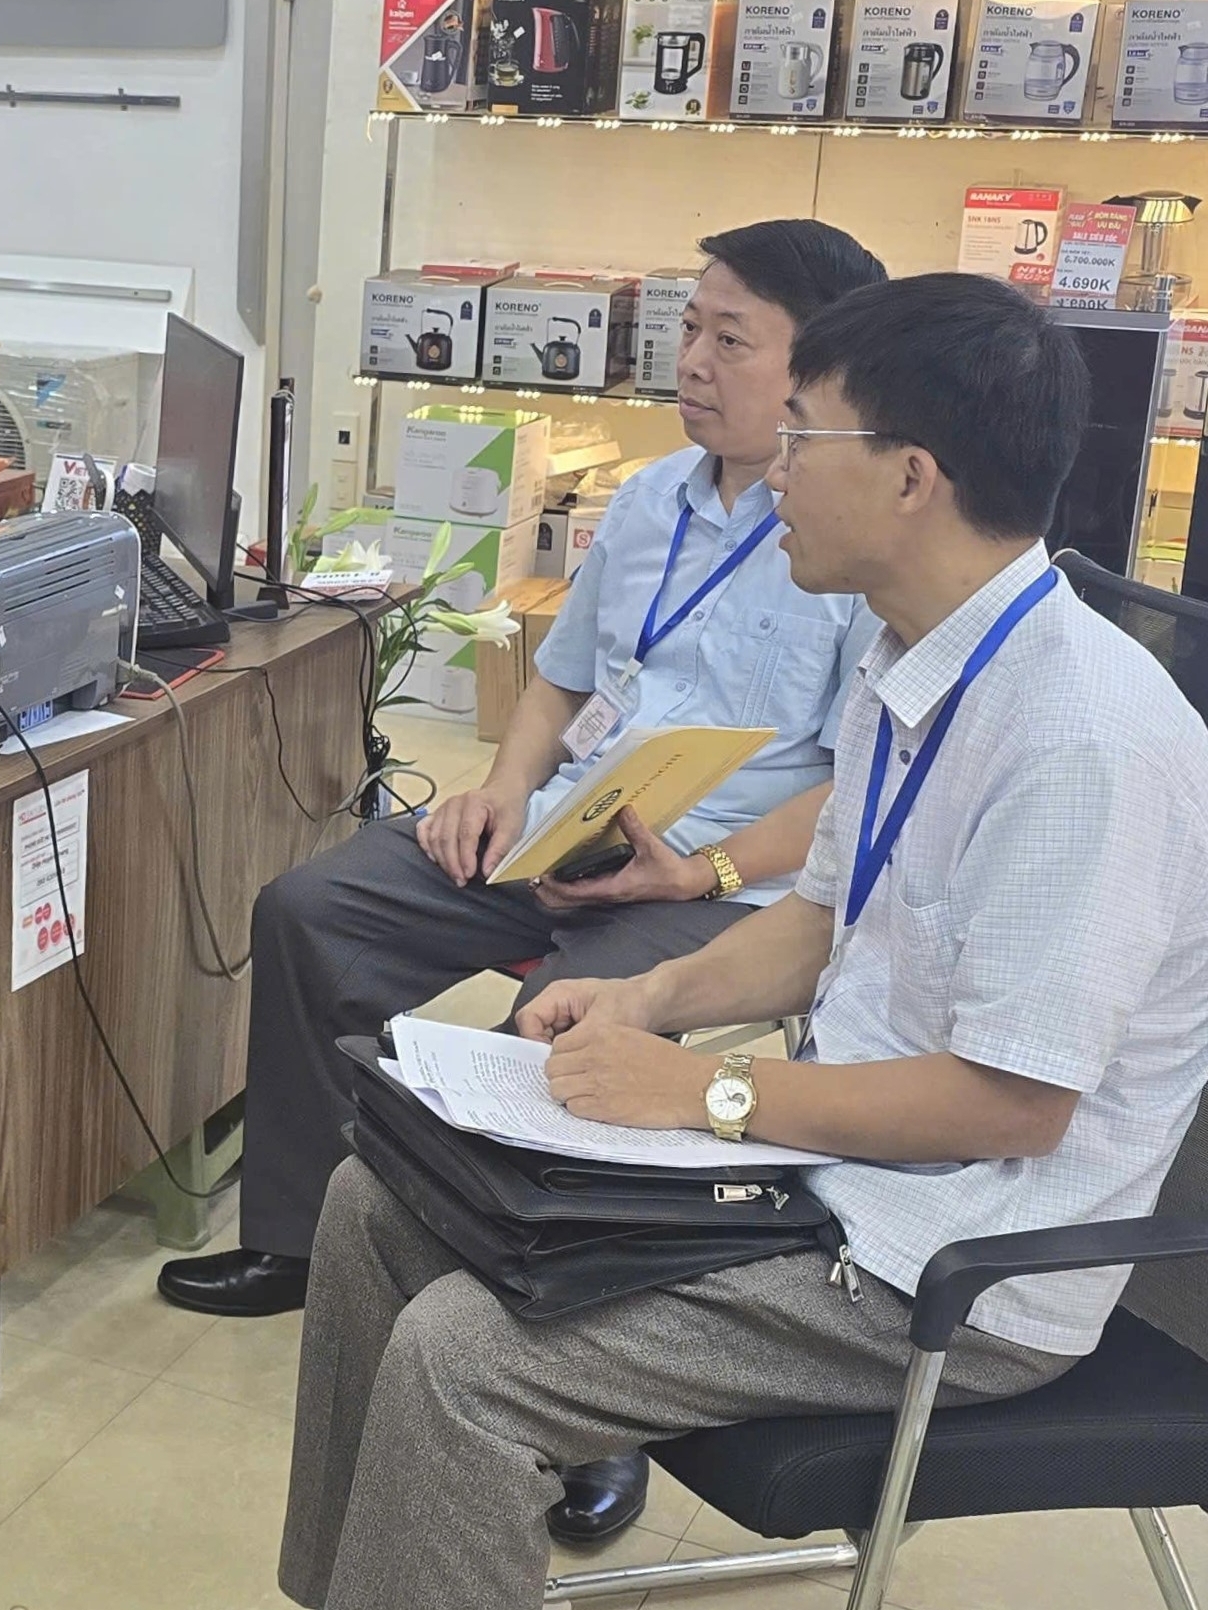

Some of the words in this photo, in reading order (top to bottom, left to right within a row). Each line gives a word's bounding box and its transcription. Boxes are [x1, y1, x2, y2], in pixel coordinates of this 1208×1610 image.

[745, 6, 790, 15] KORENO
[864, 7, 912, 16] KORENO
[986, 6, 1033, 16] KORENO
[1132, 9, 1181, 19] KORENO
[1064, 255, 1116, 267] 6.700.000K
[1016, 265, 1053, 275] NEW
[1058, 276, 1111, 291] 4.690K
[372, 293, 414, 304] KORENO
[647, 289, 689, 299] KORENO
[495, 301, 539, 312] KORENO
